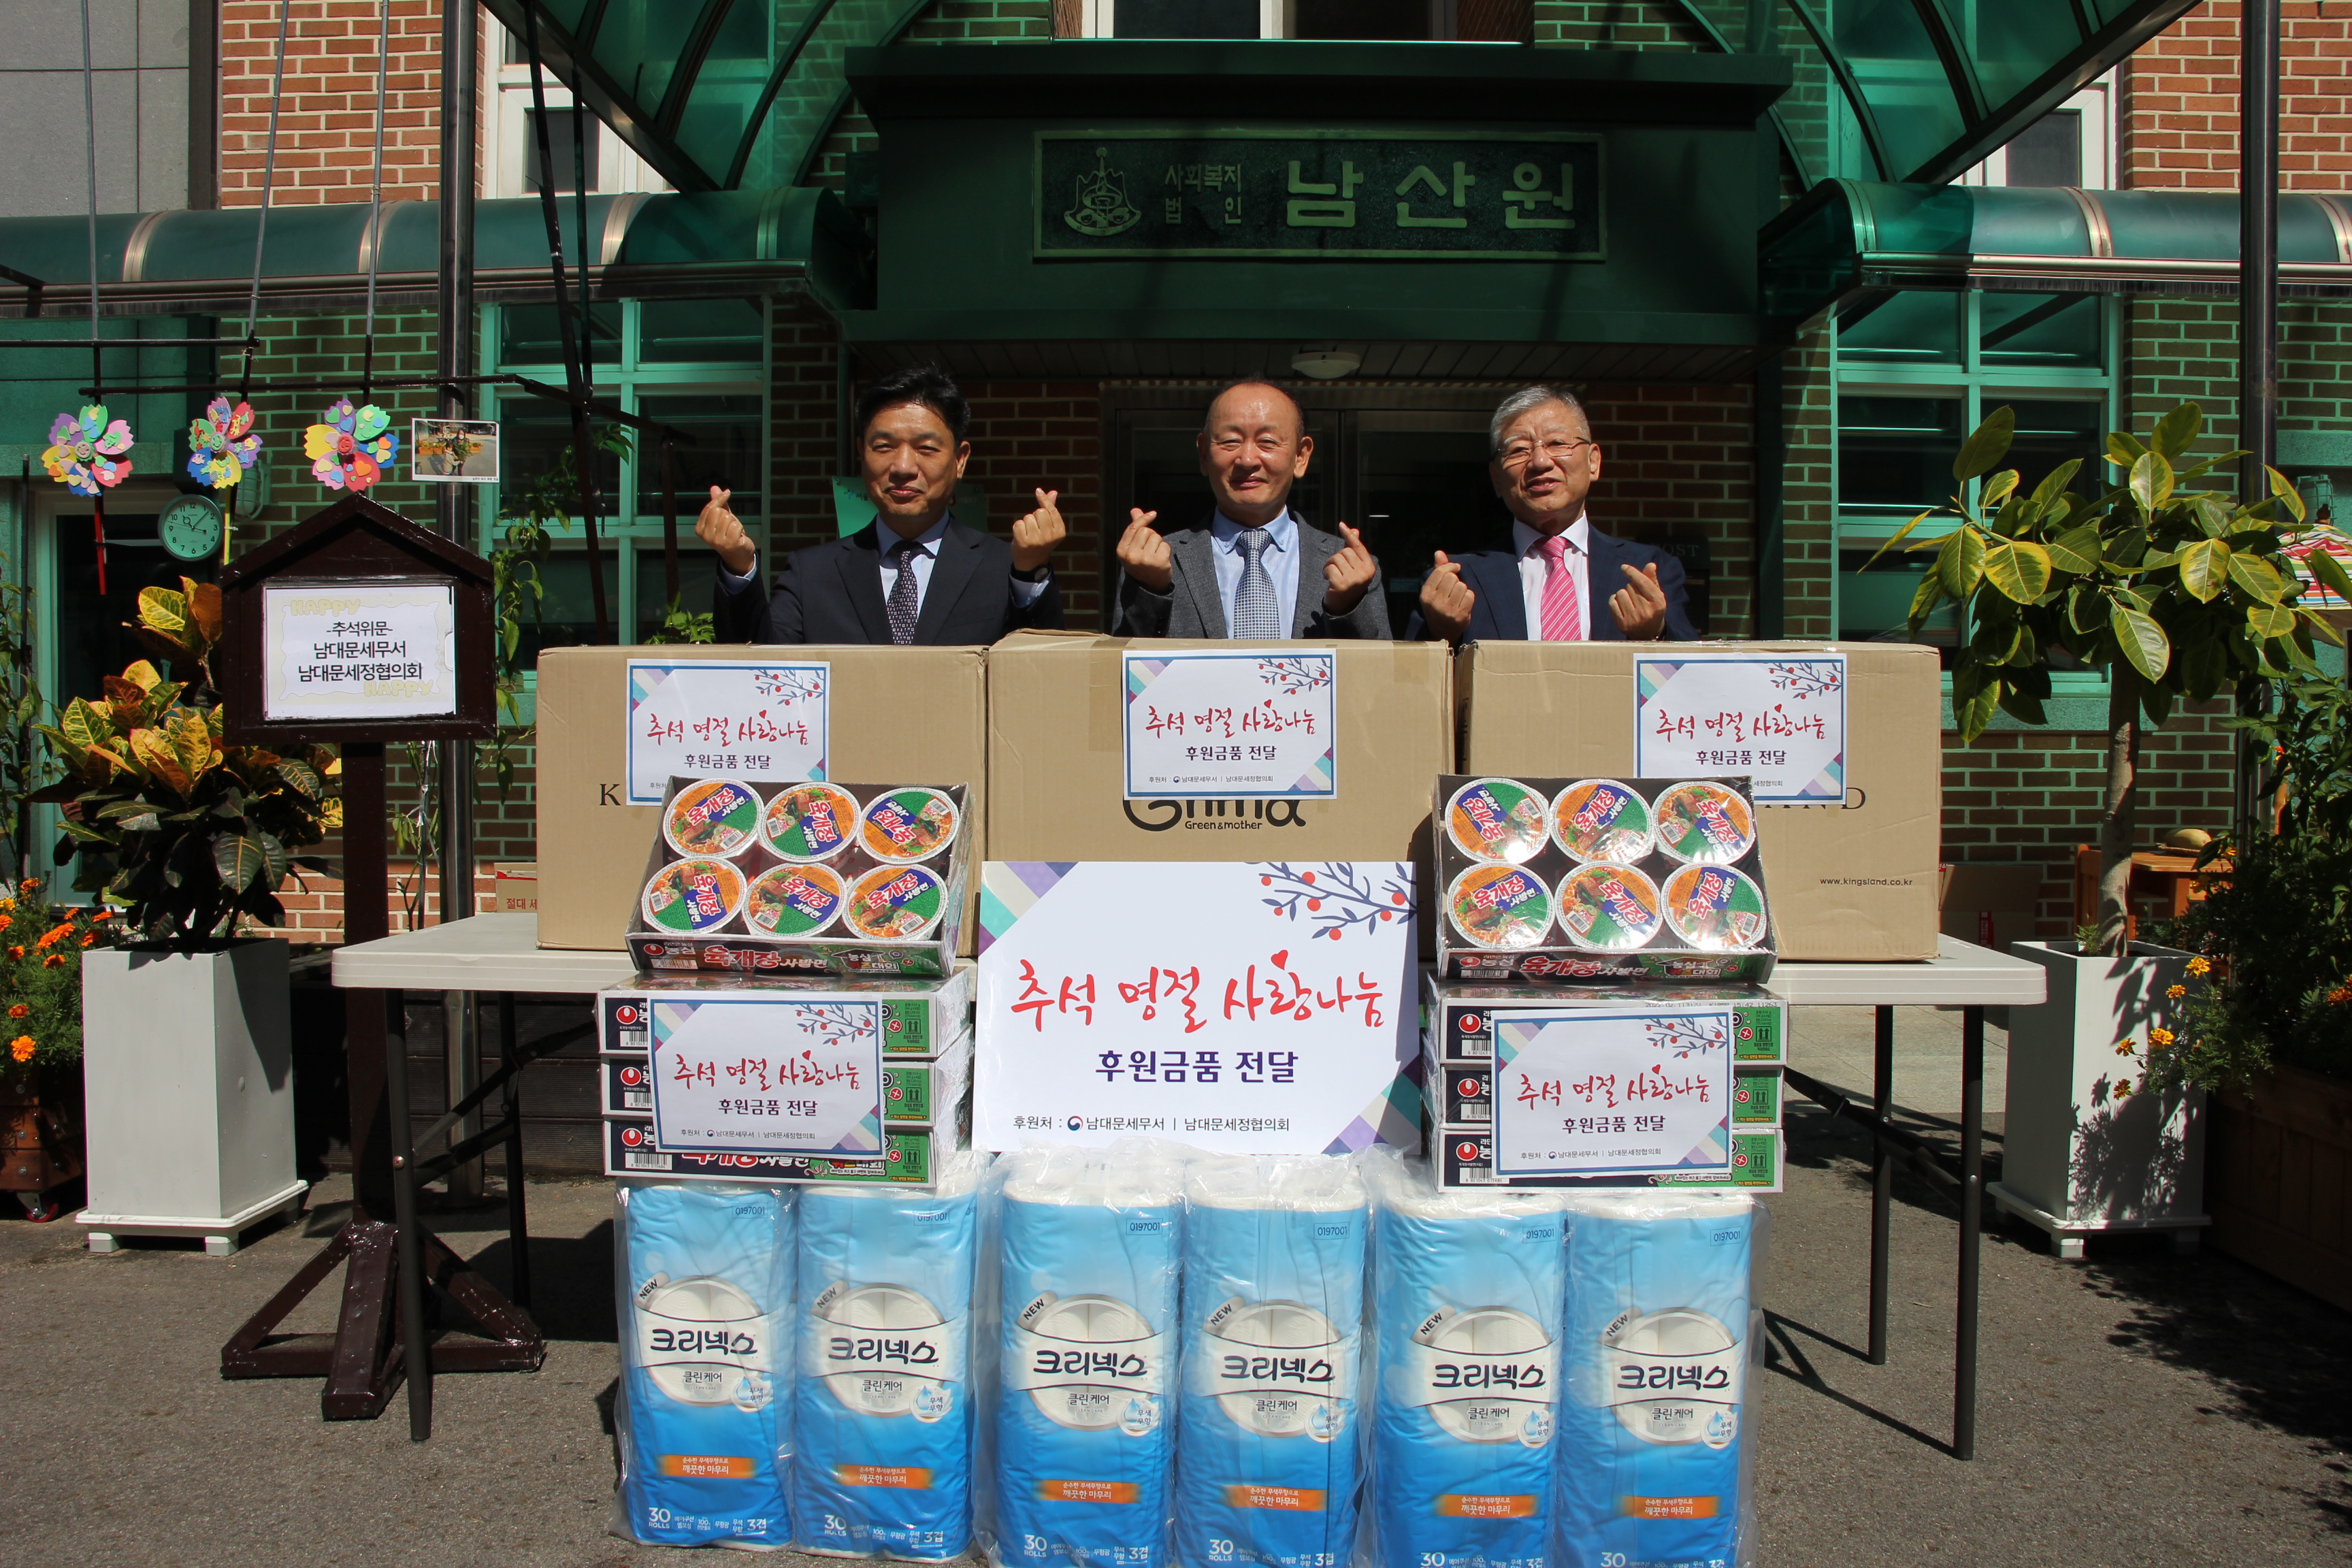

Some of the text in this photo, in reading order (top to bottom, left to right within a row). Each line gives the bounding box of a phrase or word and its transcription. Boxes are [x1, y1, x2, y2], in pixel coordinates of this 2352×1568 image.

[1164, 164, 1241, 193] 사회복지
[1287, 160, 1575, 229] 남산원
[291, 599, 361, 617] HAPPY
[314, 640, 406, 659] 남대문세무서
[298, 662, 423, 682] 남대문세정협의회
[363, 679, 434, 698] HAPPY
[647, 710, 809, 747] 추석 명절 사랑나눔
[1146, 700, 1316, 739] 추석 명절 사랑나눔
[1656, 704, 1827, 743] 추석 명절 사랑나눔
[683, 754, 771, 770] 후원금품 전달
[1185, 745, 1277, 761] 후원금품 전달
[1695, 750, 1787, 766] 후원금품 전달
[1225, 775, 1273, 783] 남대문세정협의회
[687, 787, 735, 826] 육개장
[1574, 789, 1615, 832] 육개장
[808, 801, 837, 843] 육개장
[872, 809, 916, 843] 육개장
[1463, 798, 1505, 841] 육개장
[1696, 800, 1740, 844] 육개장
[867, 873, 918, 909] 육개장
[1472, 875, 1525, 910] 육개장
[1820, 878, 1913, 887] www.kingsland.co.kr
[693, 875, 721, 917] 육개장
[782, 877, 832, 909] 육개장
[1599, 881, 1648, 924] 육개장
[1688, 872, 1723, 919] 육개장
[506, 898, 525, 910] 절대
[704, 945, 828, 969] 육개장 사발면
[1519, 956, 1650, 977] 육개장 사발면
[1011, 950, 1384, 1034] 추석 명절 사랑나눔
[674, 1050, 860, 1092] 추석 명절 사랑나눔
[1095, 1050, 1299, 1083] 후원금품 전달
[1517, 1064, 1711, 1110] 추석 명절 사랑나눔
[718, 1098, 818, 1117] 후원금품 전달
[1013, 1115, 1290, 1132] 후원처 남대문세무서 남대문세정협의회
[1562, 1115, 1666, 1134] 후원금품 전달
[681, 1129, 815, 1140] 후원처 남대문세무서 남대문세정협의회
[1520, 1147, 1661, 1160] 후원처 남대문세무서 남대문세정협의회
[735, 1207, 766, 1215] 0197001
[917, 1211, 948, 1222] 0197001
[1130, 1222, 1160, 1232] 0197001
[1317, 1226, 1348, 1236] 0197001
[1526, 1228, 1555, 1239] 0197001
[1713, 1231, 1741, 1242] 0197001
[638, 1279, 658, 1300] NEW
[817, 1287, 837, 1309] NEW
[1023, 1298, 1045, 1320] NEW
[1210, 1303, 1232, 1326] NEW
[1420, 1313, 1443, 1335] NEW
[1605, 1314, 1629, 1337] NEW
[650, 1328, 758, 1356] 크리넥스
[828, 1337, 939, 1365] 크리넥스
[1033, 1350, 1148, 1378] 크리넥스
[1220, 1355, 1336, 1384] 크리넥스
[1432, 1364, 1546, 1390] 크리넥스
[1617, 1365, 1730, 1391] 크리넥스
[929, 1404, 943, 1412] 무향
[683, 1465, 729, 1475] 깨끗한 마무리
[859, 1474, 906, 1484] 깨끗한 마무리
[1062, 1490, 1111, 1499] 깨끗한 마무리
[1250, 1495, 1298, 1507] 깨끗한 마무리
[649, 1507, 671, 1523] 30
[1461, 1504, 1511, 1516] 깨끗한 마무리
[1645, 1506, 1693, 1517] 깨끗한 마무리
[824, 1514, 847, 1531] 30
[1024, 1534, 1047, 1552] 30
[1209, 1539, 1234, 1555] 30
[1024, 1550, 1046, 1558] ROLLS
[1420, 1552, 1446, 1567] 30
[1601, 1552, 1626, 1568] 30
